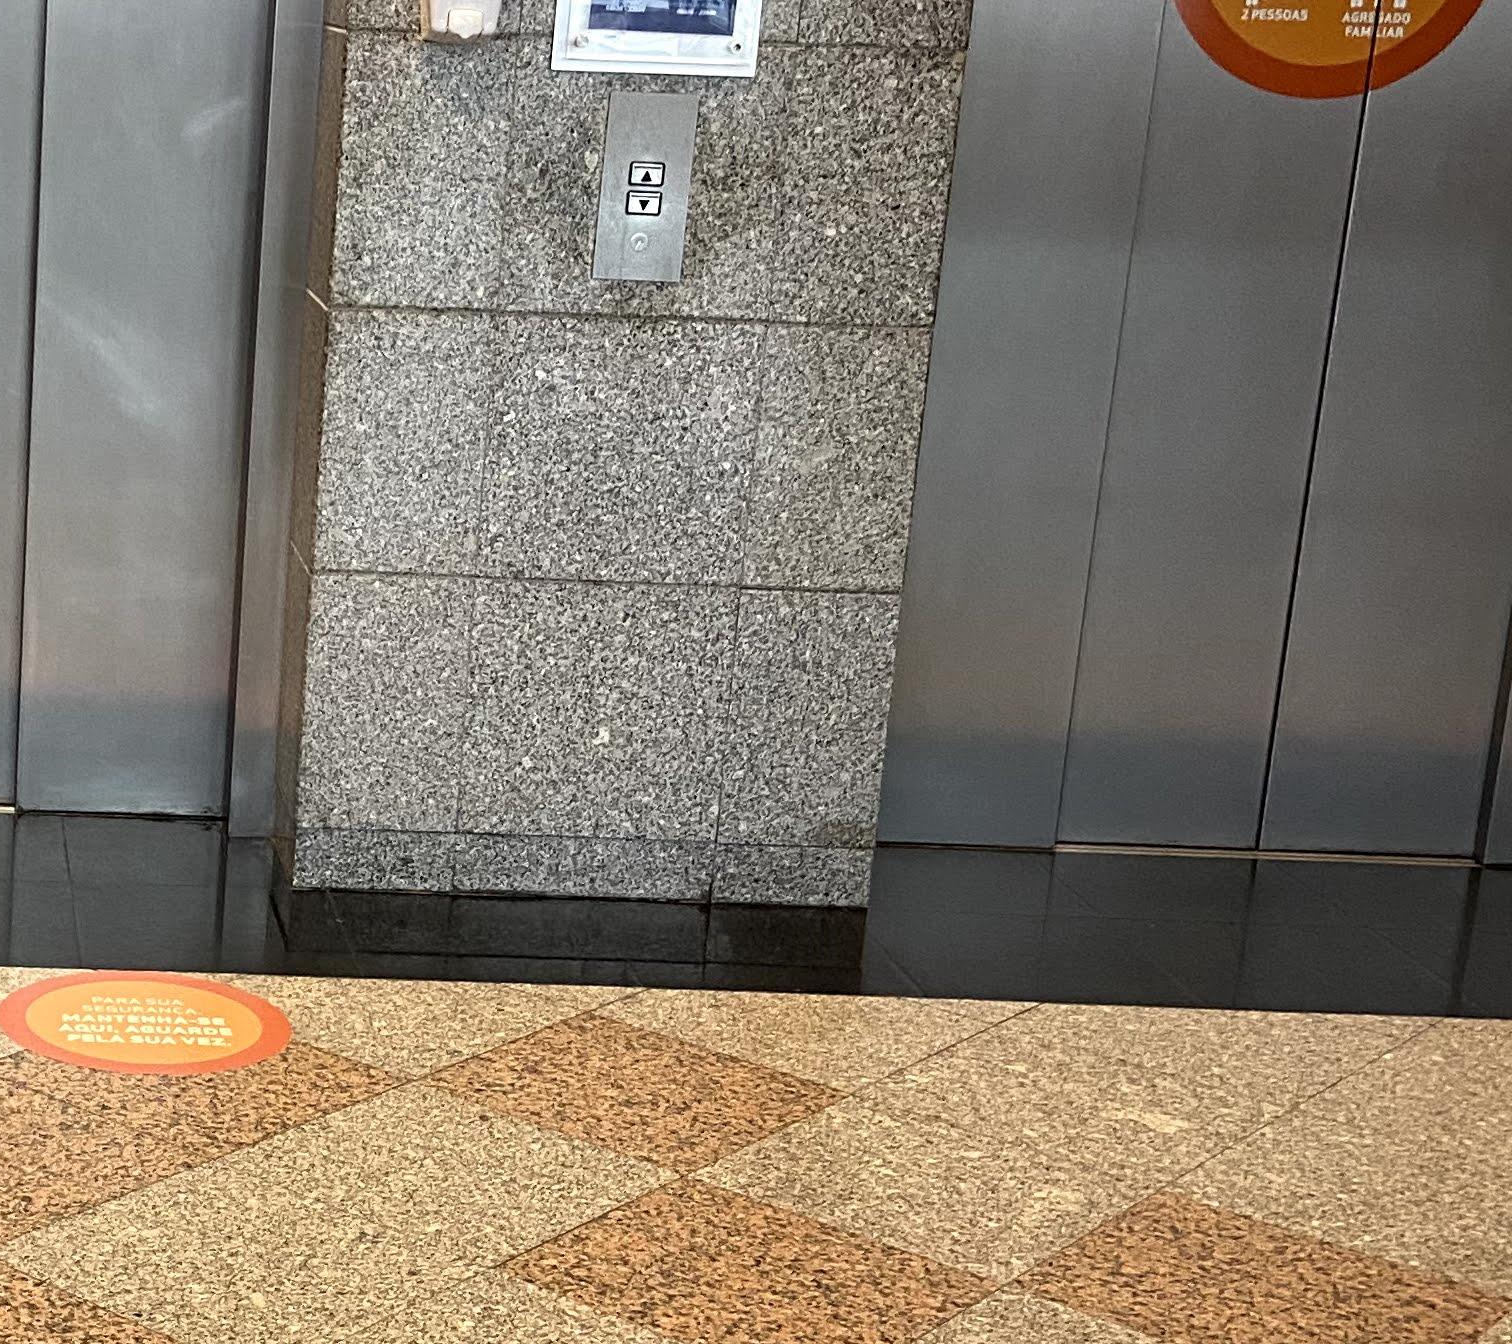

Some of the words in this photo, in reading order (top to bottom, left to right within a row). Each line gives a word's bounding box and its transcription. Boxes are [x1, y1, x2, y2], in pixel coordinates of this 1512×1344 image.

[1250, 9, 1308, 21] PESSOAS
[91, 996, 141, 1006] PARA
[145, 997, 185, 1007] SUA
[61, 1013, 227, 1027] MANTENHA-SE
[123, 1025, 233, 1037] AGUARDE
[67, 1033, 126, 1044] PELA
[130, 1035, 178, 1046] SUA
[180, 1036, 233, 1048] VEZ.
